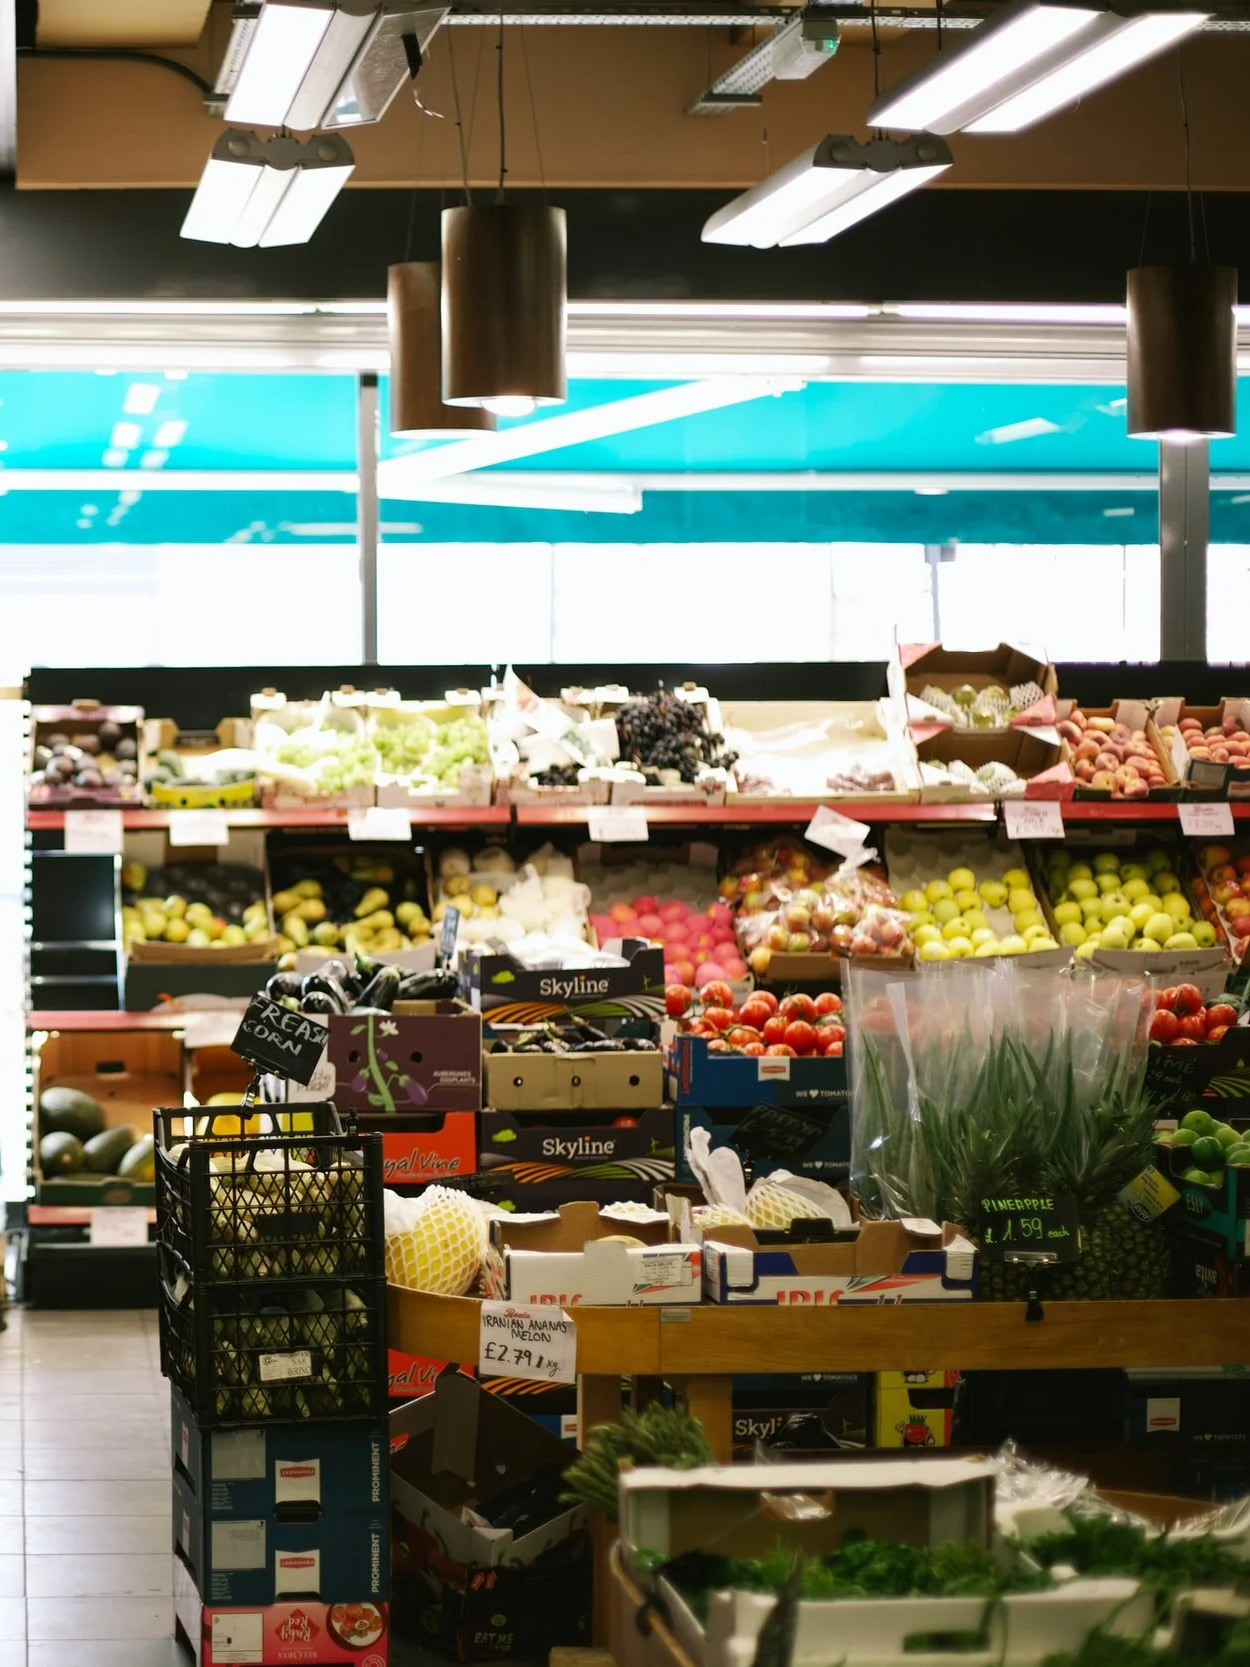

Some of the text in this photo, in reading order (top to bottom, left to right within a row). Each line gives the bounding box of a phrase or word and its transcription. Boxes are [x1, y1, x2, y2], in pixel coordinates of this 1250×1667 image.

[539, 975, 610, 999] Skyline
[242, 1020, 303, 1056] CORN
[795, 1090, 808, 1098] WE
[542, 1136, 616, 1159] Skyline
[383, 1147, 460, 1178] yal Vine
[981, 1199, 1054, 1213] PINEAPPLE
[1048, 1225, 1070, 1238] each
[483, 1314, 567, 1334] IRANIAN ANANAS
[511, 1329, 551, 1343] MELON
[371, 1441, 381, 1502] PROMINENT
[371, 1533, 380, 1593] PROMINENT
[287, 1615, 308, 1630] Red
[280, 1625, 311, 1644] Ruby
[474, 1632, 497, 1644] EAT
